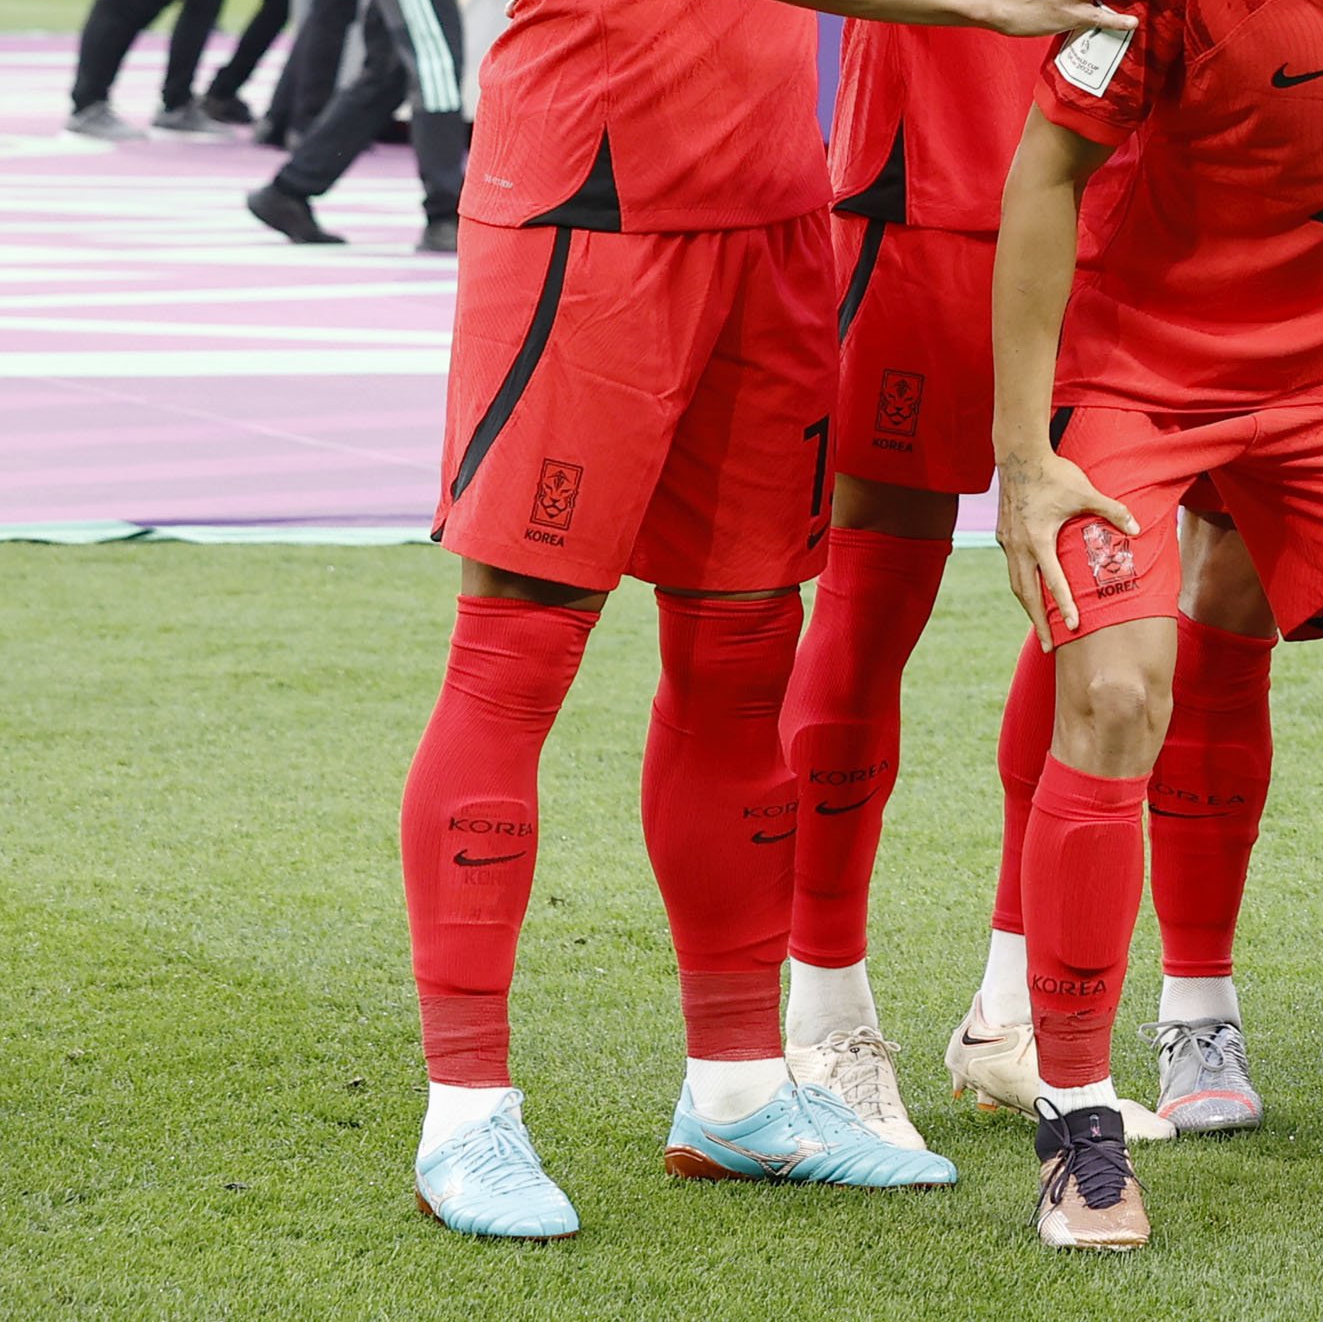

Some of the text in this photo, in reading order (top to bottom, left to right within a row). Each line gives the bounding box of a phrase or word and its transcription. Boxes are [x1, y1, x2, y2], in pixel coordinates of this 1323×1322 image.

[872, 437, 914, 454] KOREA
[803, 414, 832, 518] 1
[524, 528, 565, 547] KOREA
[1097, 578, 1141, 599] KOREA
[809, 758, 890, 786] KOREA
[1149, 782, 1246, 806] OREA
[742, 800, 799, 820] KOR
[448, 816, 533, 838] KOREA
[1032, 974, 1107, 997] KOREA
